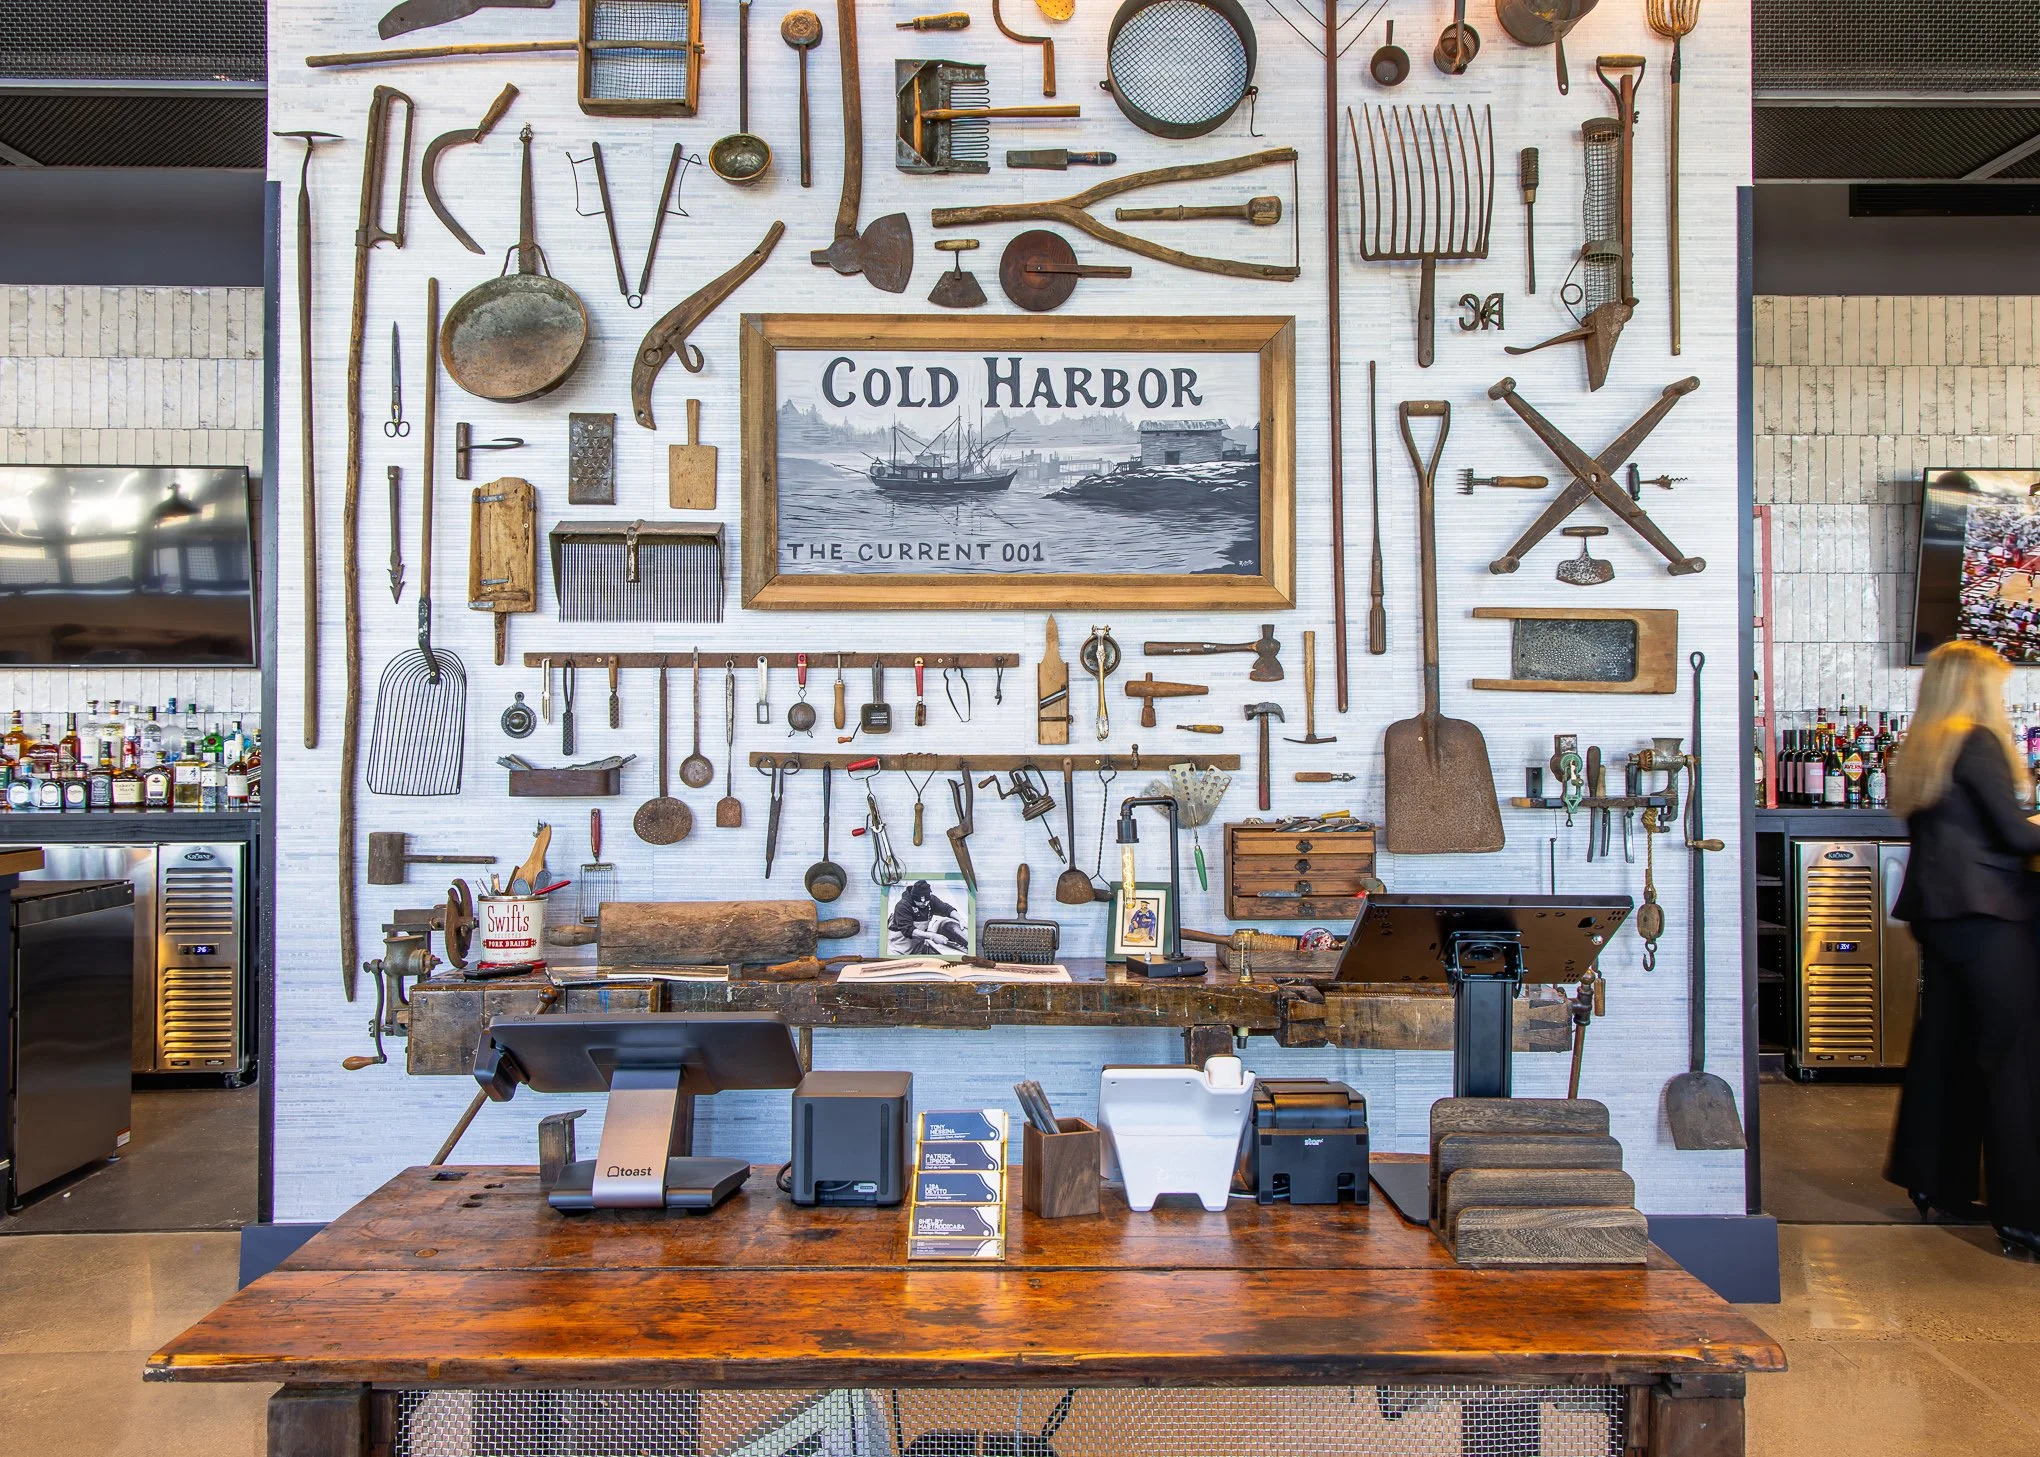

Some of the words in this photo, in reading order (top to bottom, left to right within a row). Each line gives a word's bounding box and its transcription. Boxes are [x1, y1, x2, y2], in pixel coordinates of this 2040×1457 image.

[822, 356, 959, 408] COLD
[984, 356, 1204, 409] HARBOR
[787, 543, 844, 562] THE
[858, 542, 991, 562] CURRENT
[1002, 541, 1045, 562] 001
[487, 904, 530, 933] Swift's
[488, 940, 504, 948] PORK
[505, 940, 529, 948] BRAINS
[620, 1166, 652, 1177] toast
